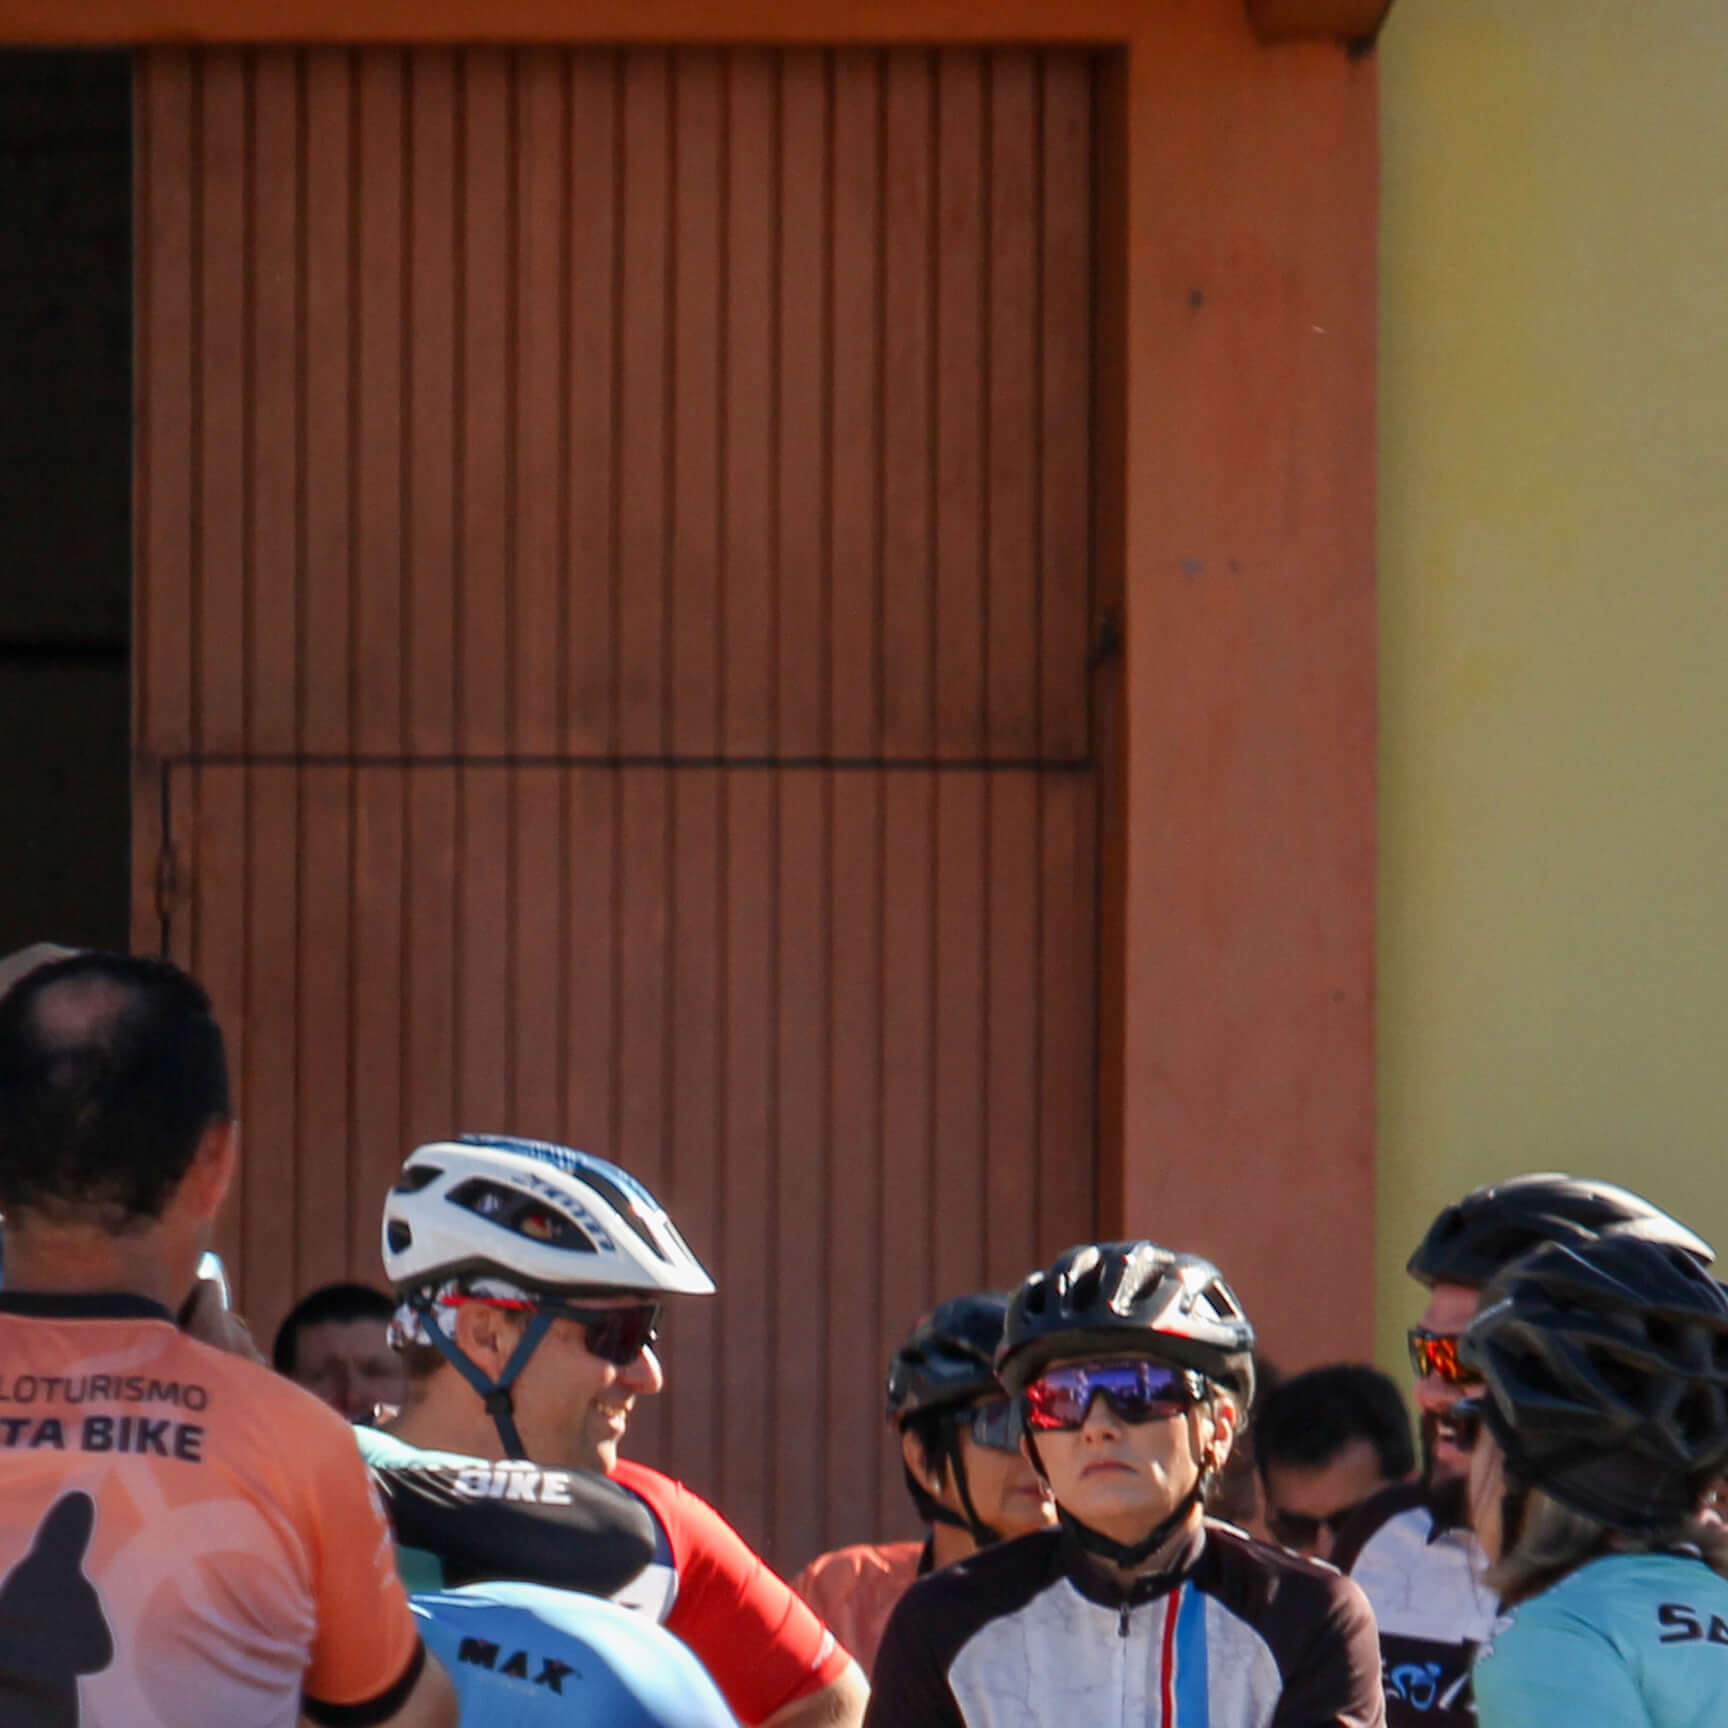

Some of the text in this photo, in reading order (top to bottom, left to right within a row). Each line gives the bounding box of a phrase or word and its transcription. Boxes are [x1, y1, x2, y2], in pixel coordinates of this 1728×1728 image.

[80, 1414, 205, 1463] BIKE
[450, 1458, 572, 1505] BIKE
[457, 1636, 576, 1696] MAX
